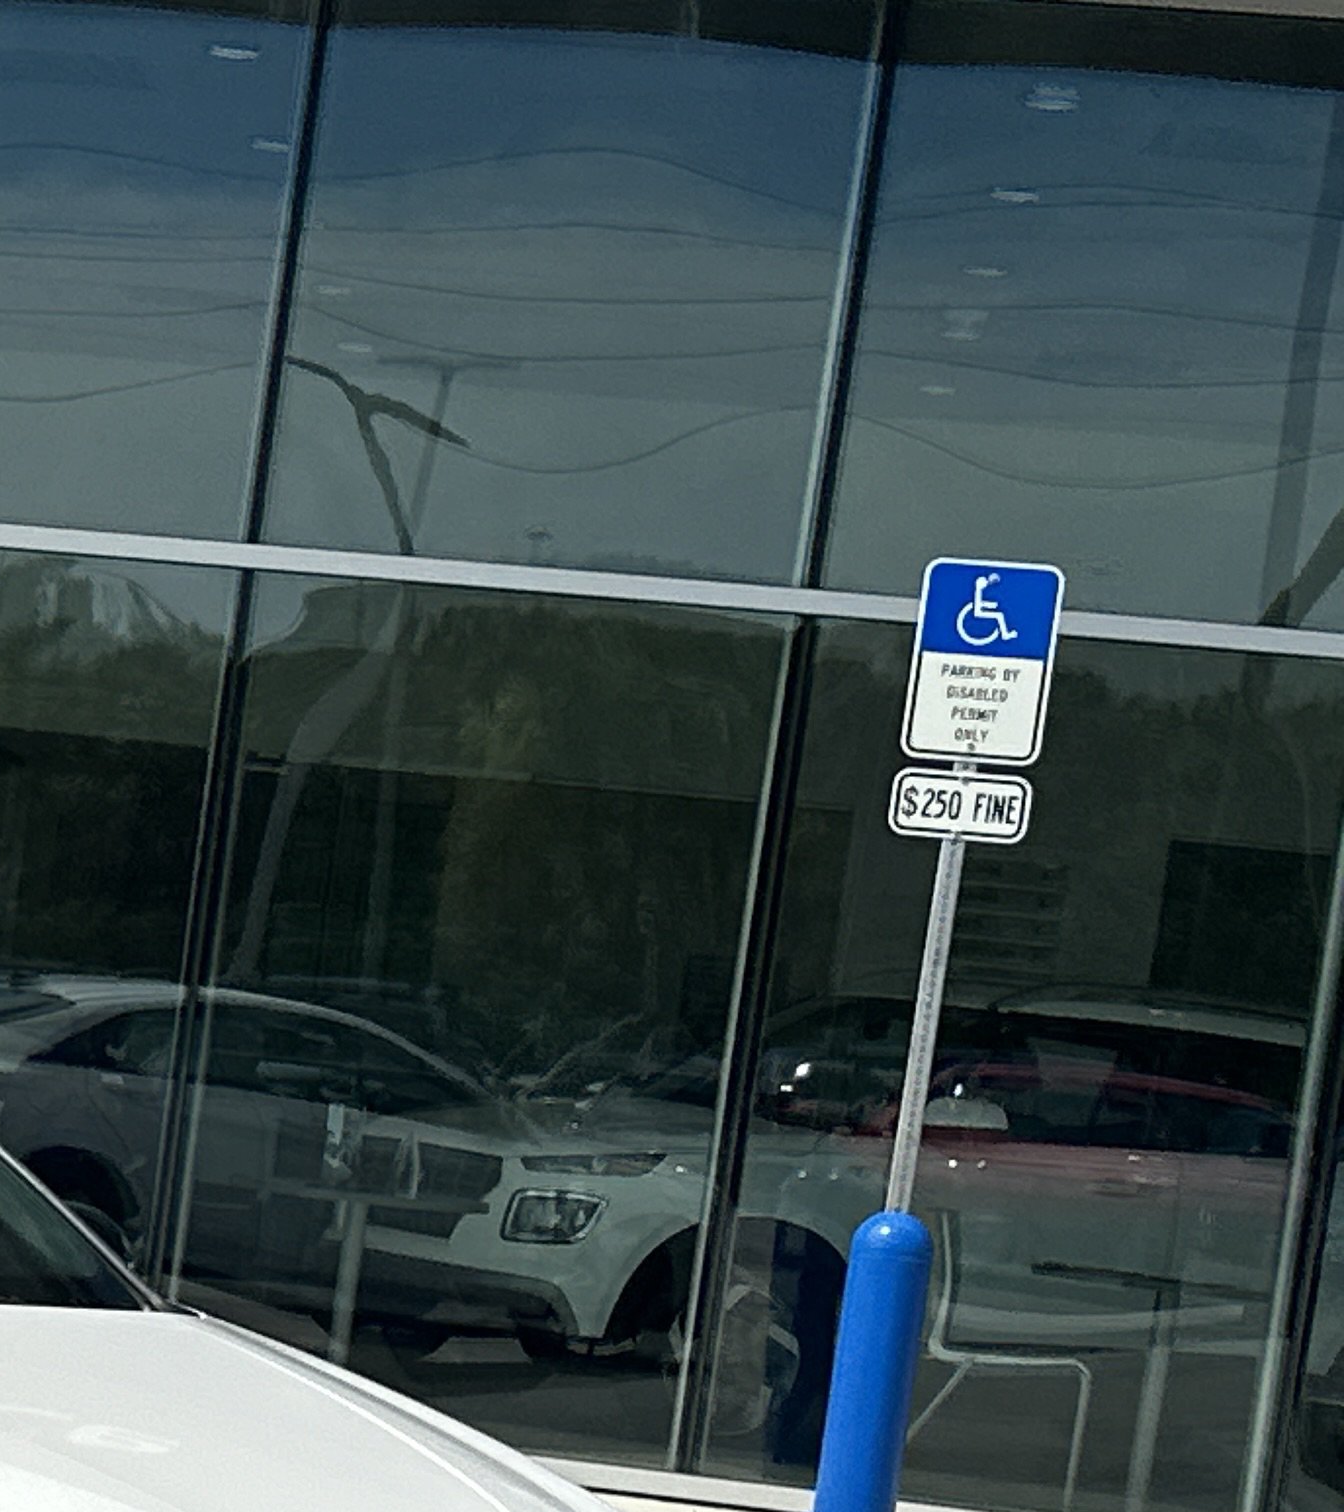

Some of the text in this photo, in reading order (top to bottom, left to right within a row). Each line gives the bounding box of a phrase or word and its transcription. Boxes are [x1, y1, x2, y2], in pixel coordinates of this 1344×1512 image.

[954, 728, 990, 742] ONLY
[901, 785, 1020, 825] $250 FINE
